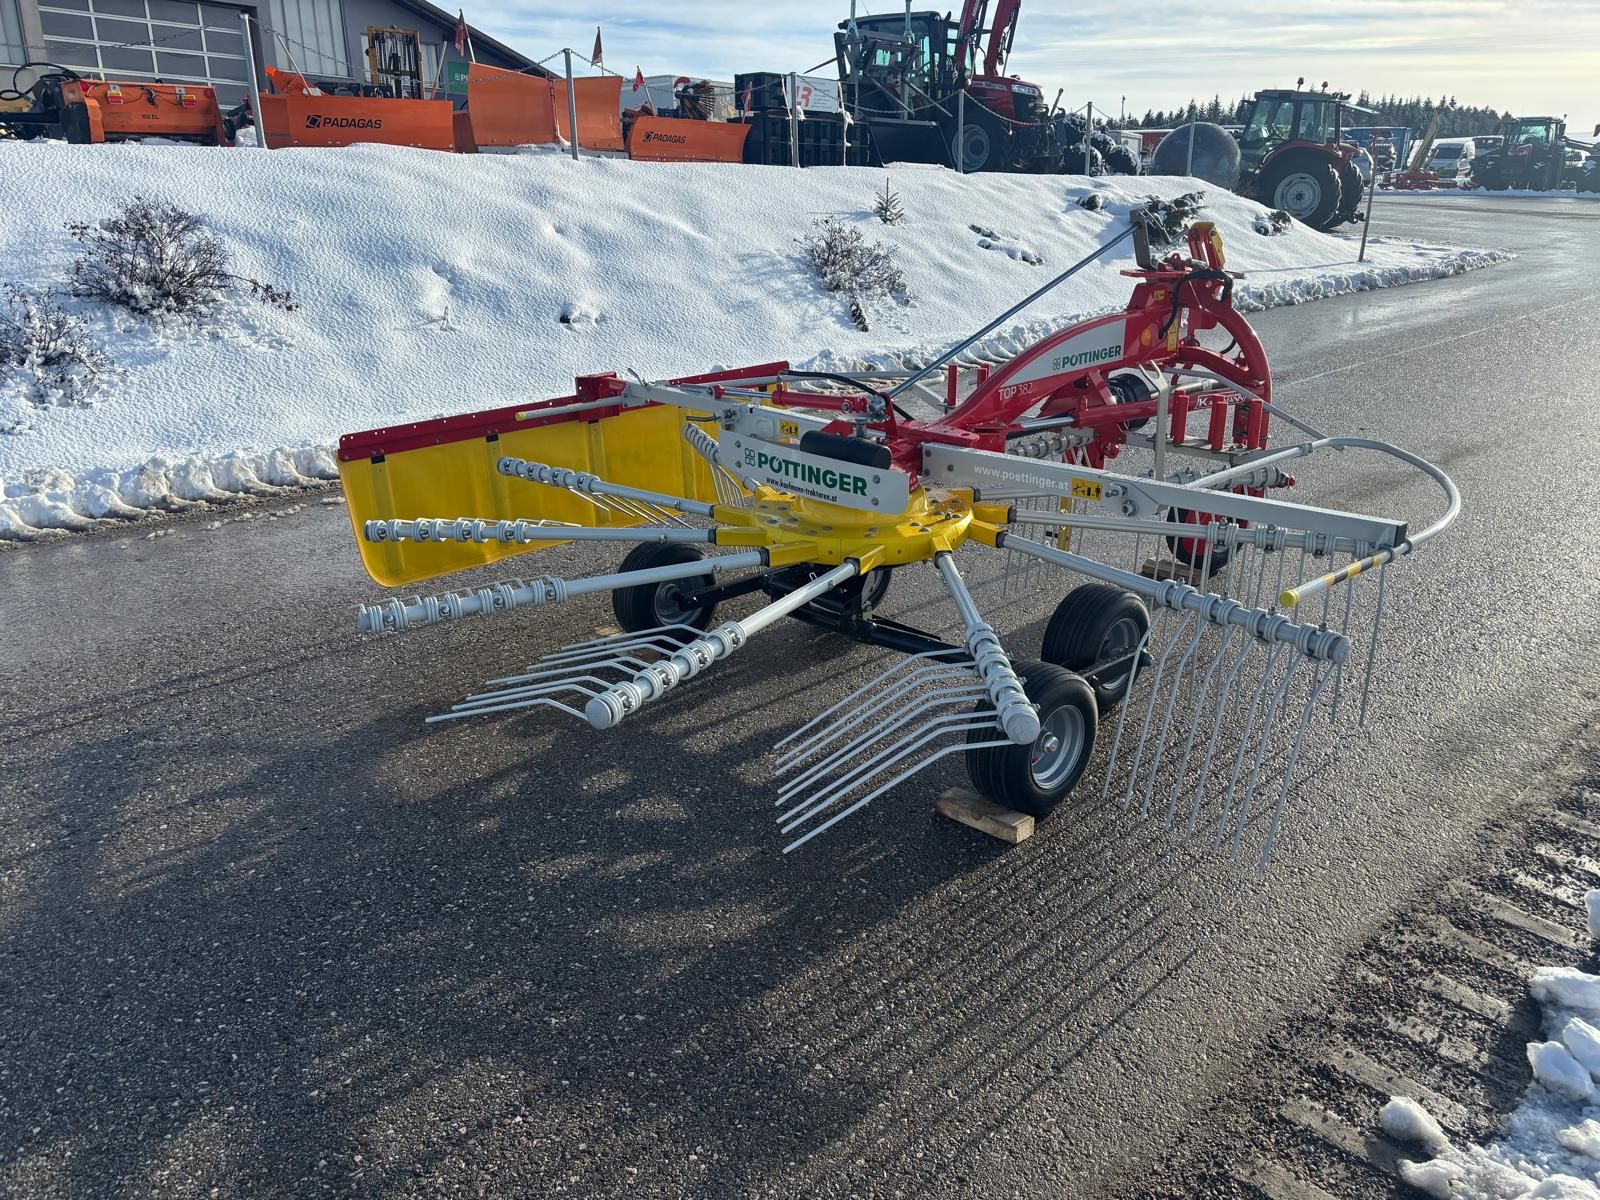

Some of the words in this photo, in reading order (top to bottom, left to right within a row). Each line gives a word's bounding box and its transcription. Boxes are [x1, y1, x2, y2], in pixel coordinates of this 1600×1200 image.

[322, 117, 383, 129] PADAGAS
[652, 133, 687, 144] PADAGAS
[998, 386, 1018, 401] TOP
[1018, 382, 1033, 397] 382
[973, 465, 1069, 490] www.poettinger.at
[766, 477, 838, 503] www.kaufmann-traktoren.at
